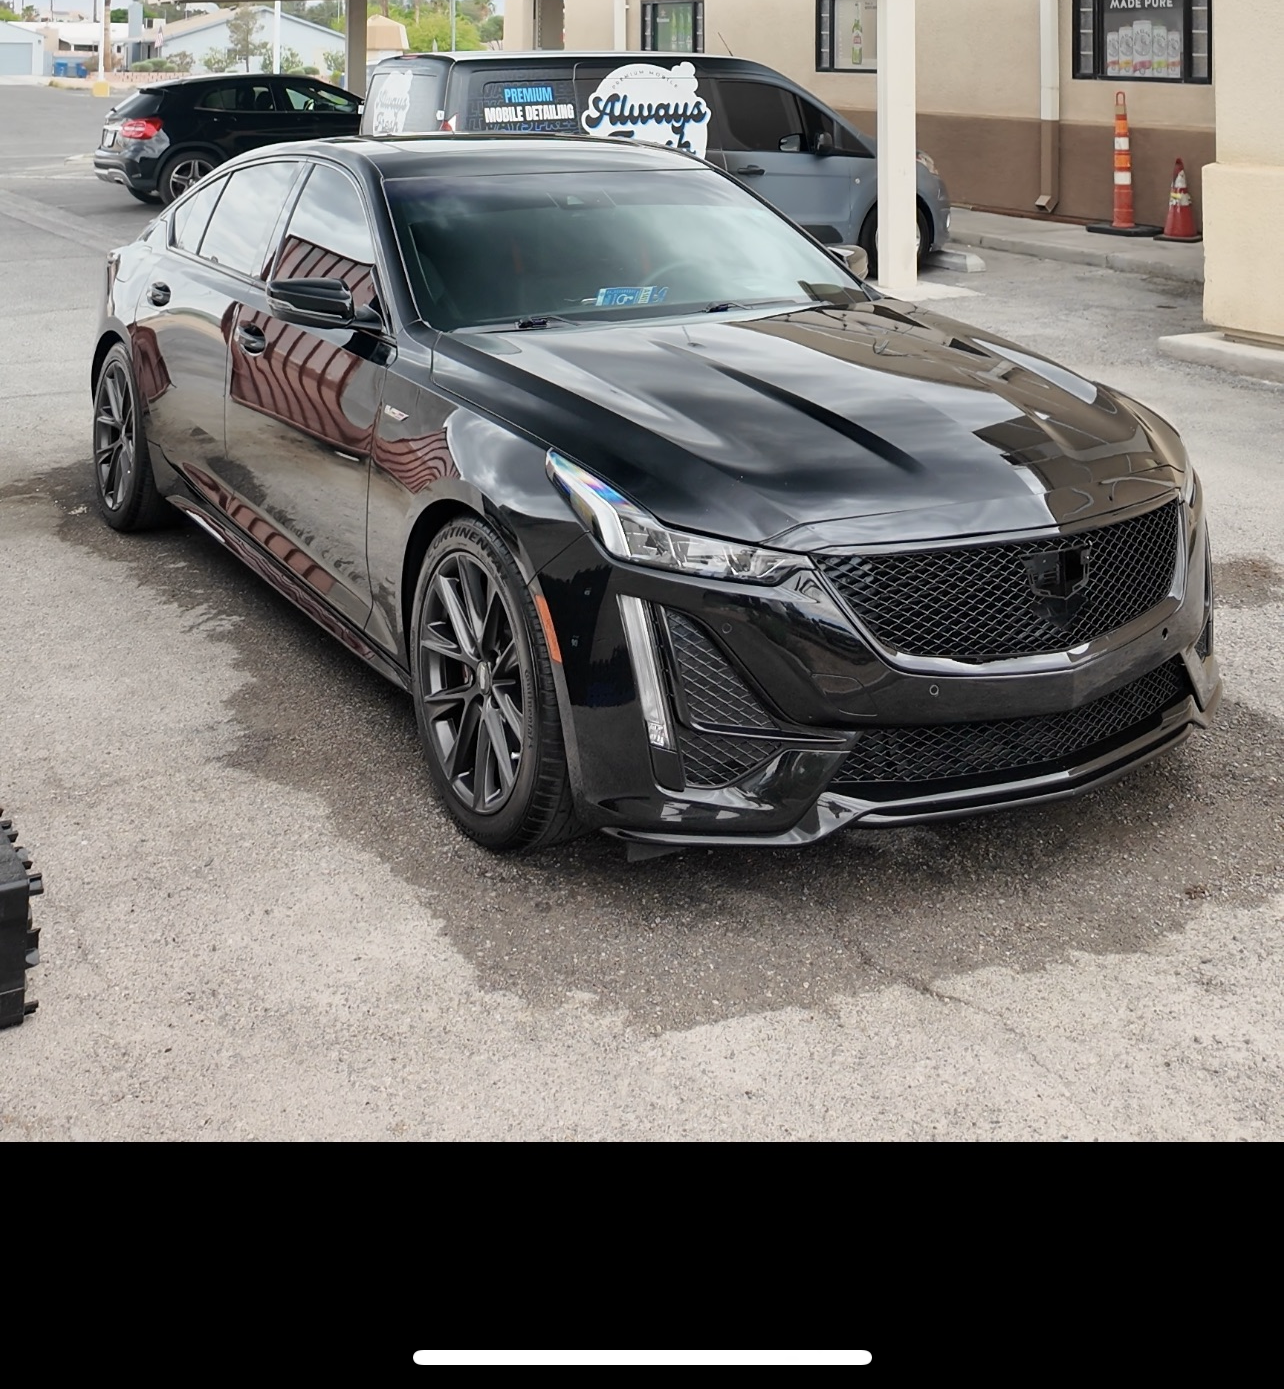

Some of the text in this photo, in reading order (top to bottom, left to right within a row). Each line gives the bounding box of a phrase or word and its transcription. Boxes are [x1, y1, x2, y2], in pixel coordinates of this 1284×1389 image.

[504, 87, 553, 103] PREMIUM
[484, 104, 575, 123] MOBILE DETAILING
[585, 93, 707, 135] Always
